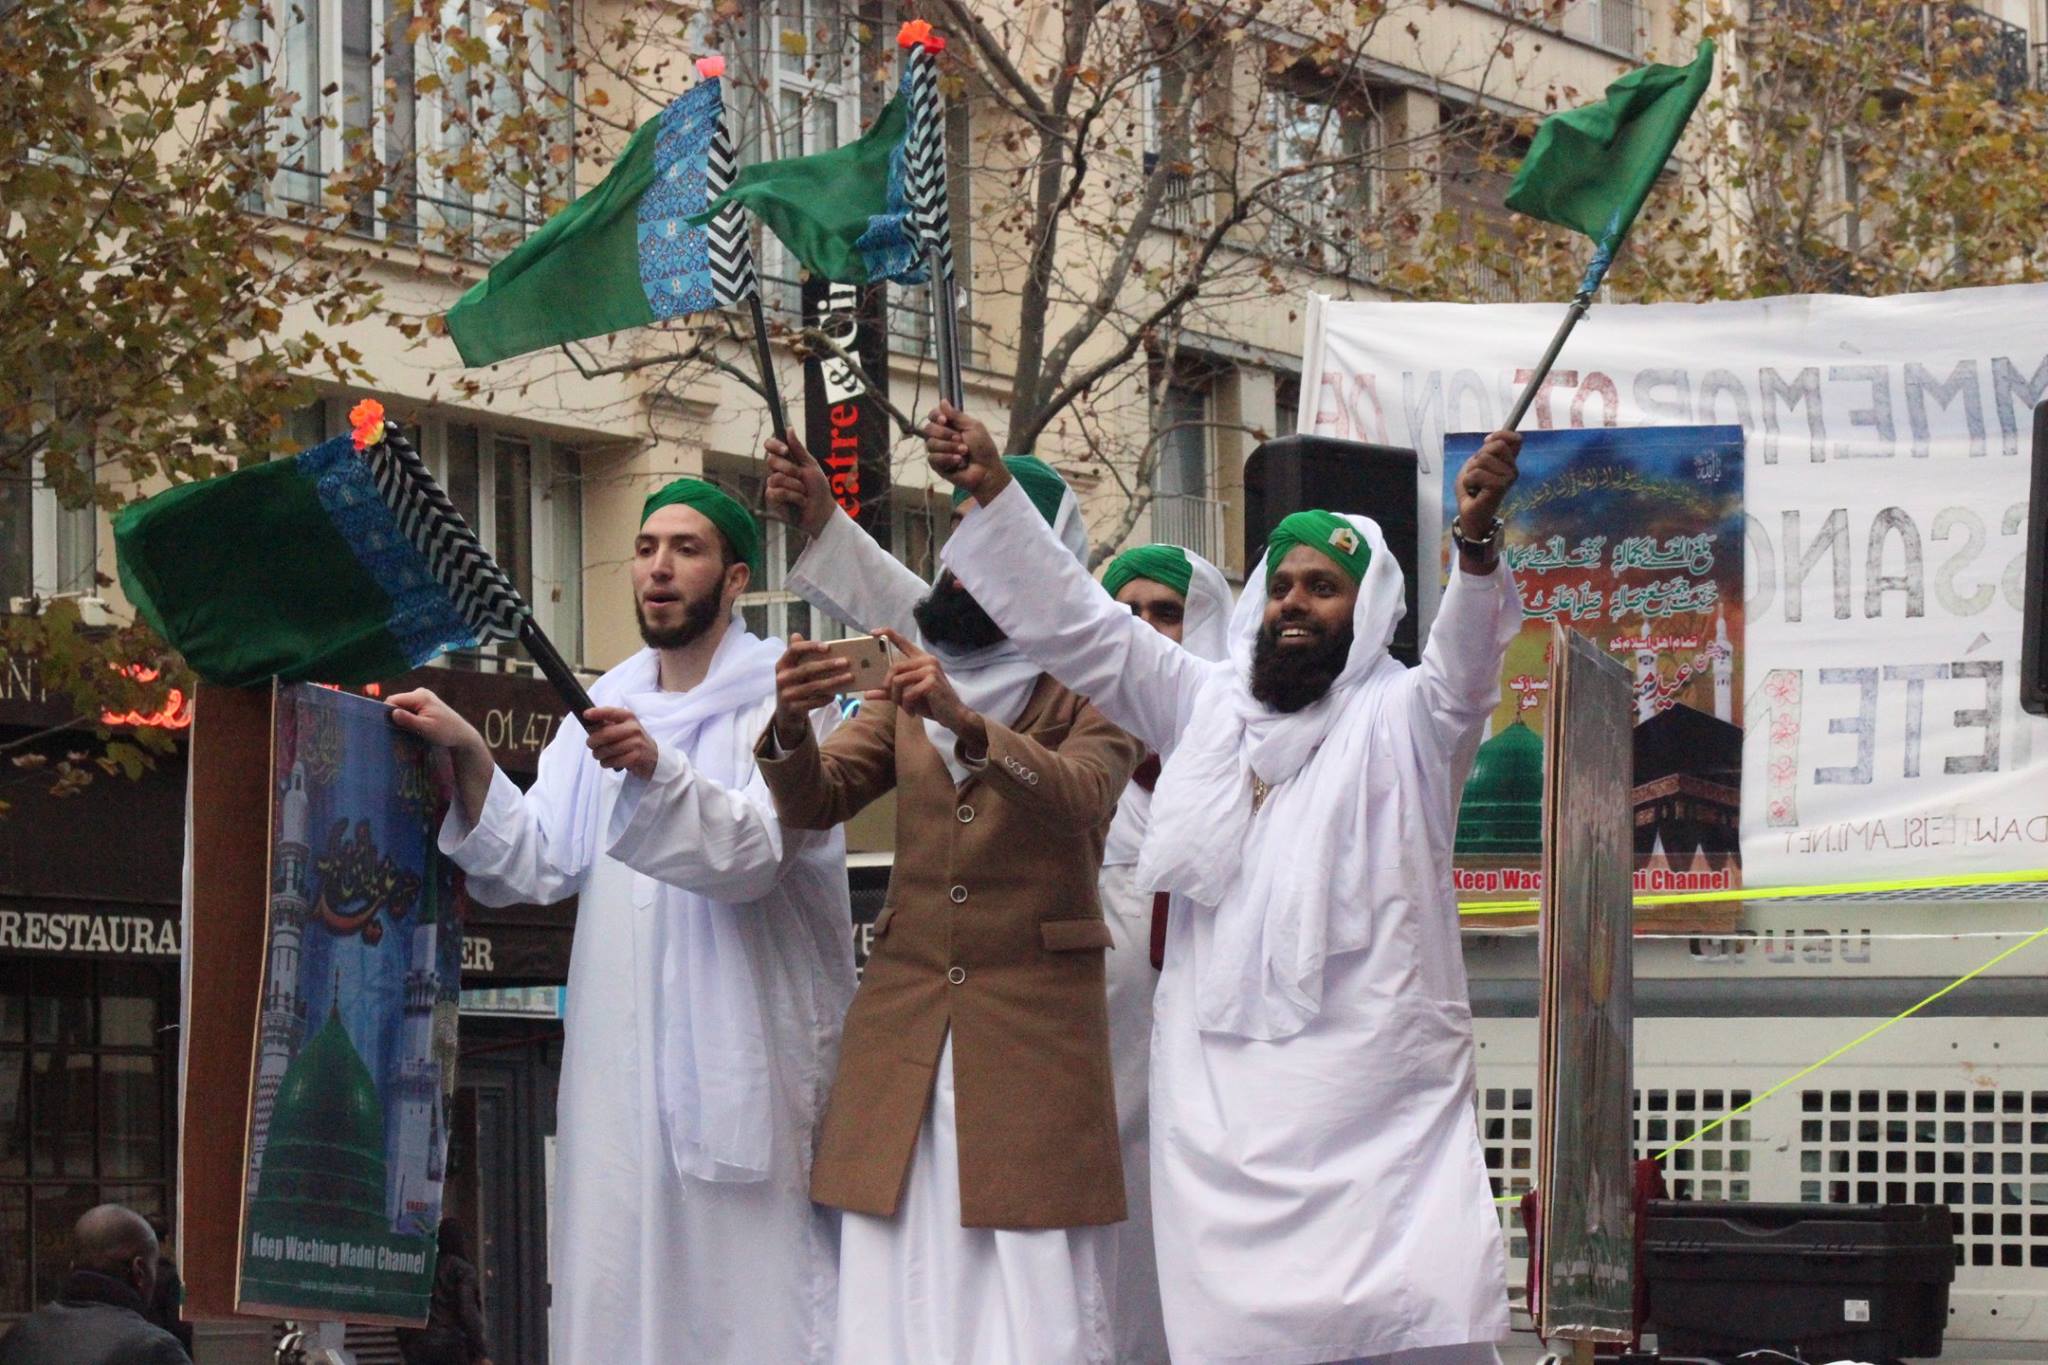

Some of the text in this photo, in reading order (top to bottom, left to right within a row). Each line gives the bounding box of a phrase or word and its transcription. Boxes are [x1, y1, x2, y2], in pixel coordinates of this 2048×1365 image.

[1453, 869, 1497, 891] Keep
[1651, 869, 1729, 889] Channel
[0, 911, 494, 971] RESTAURA ER
[252, 1232, 426, 1274] Keep Waching Madni Channel
